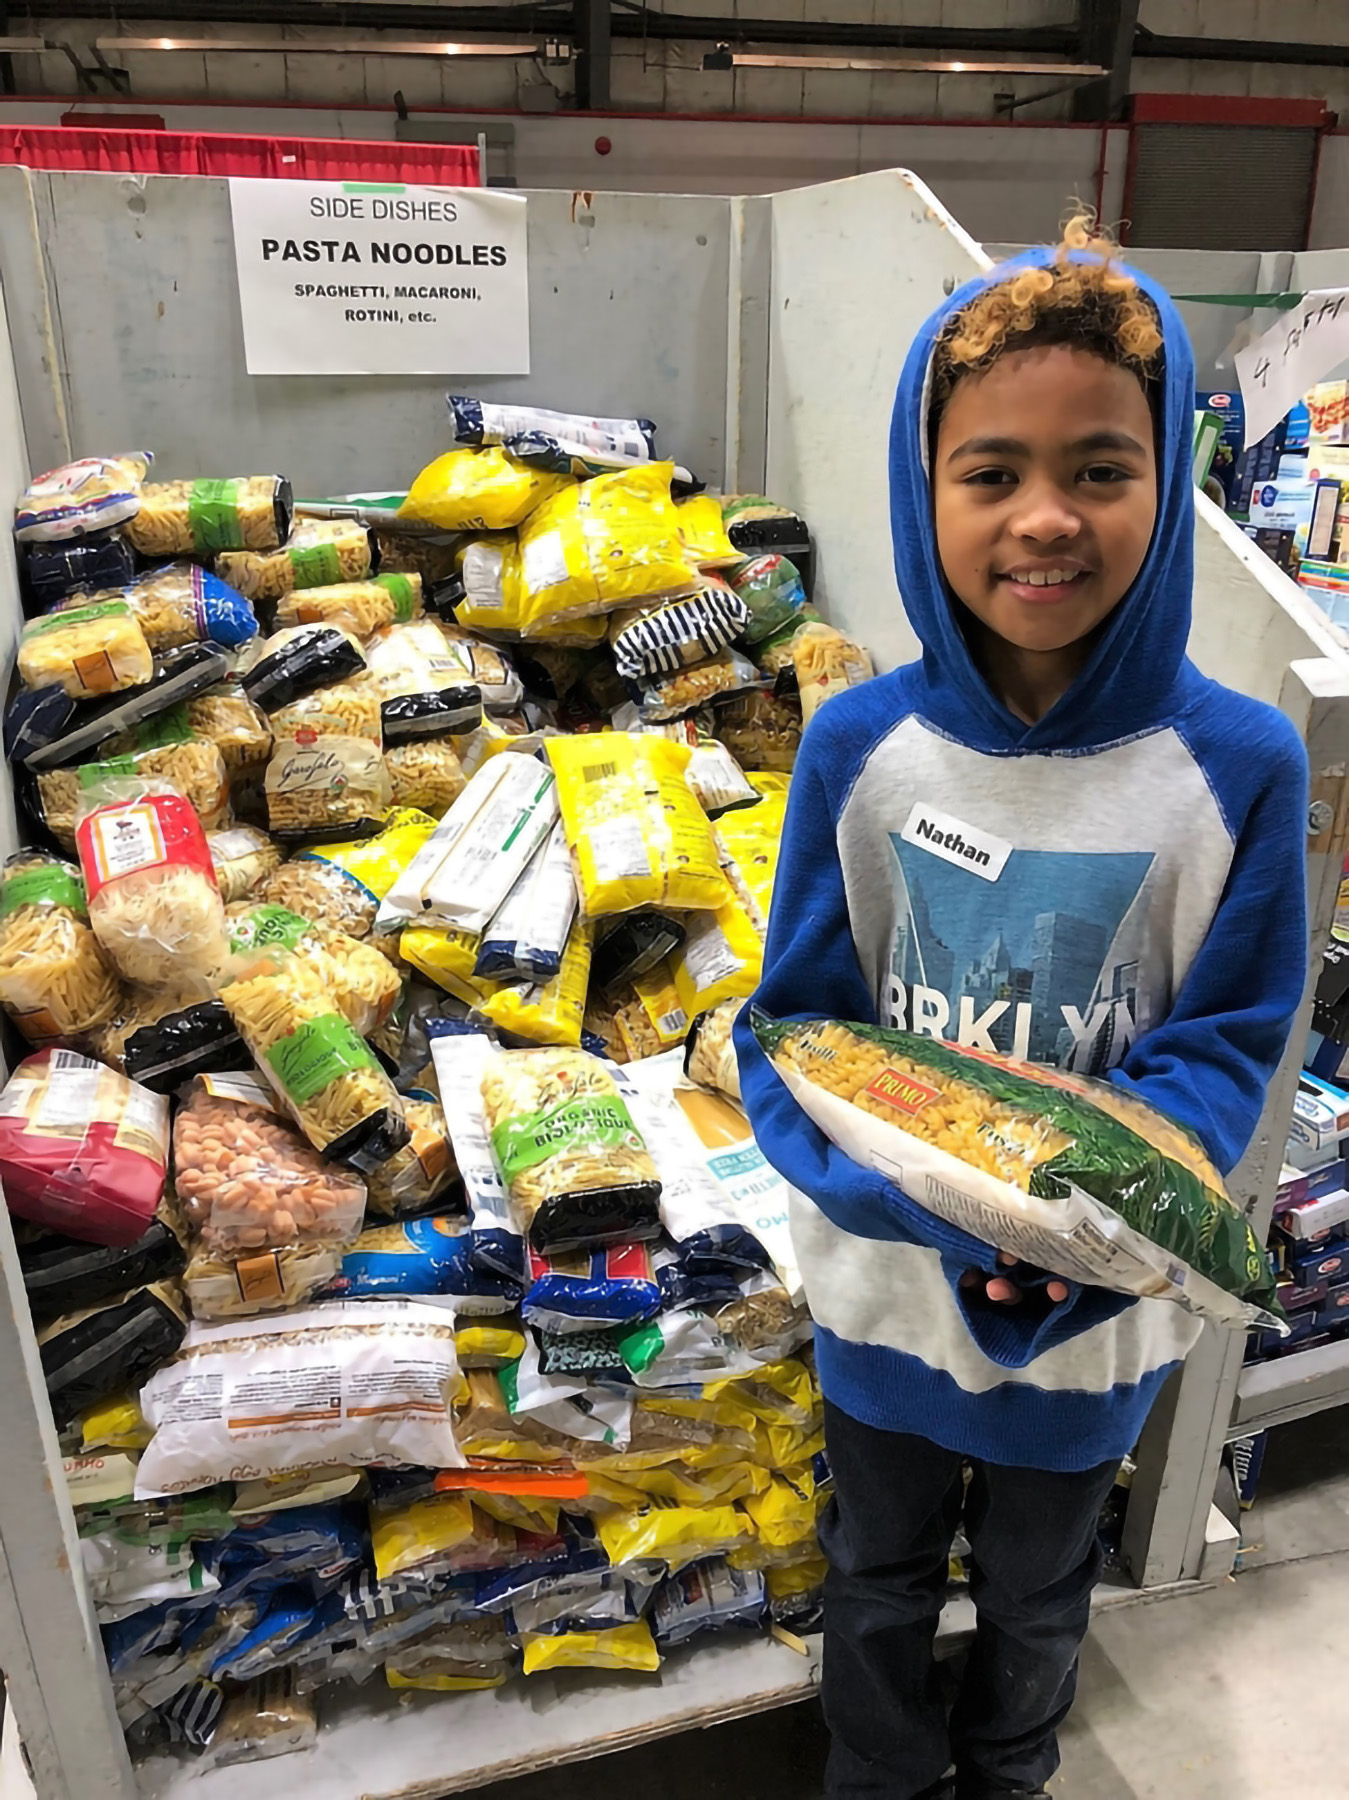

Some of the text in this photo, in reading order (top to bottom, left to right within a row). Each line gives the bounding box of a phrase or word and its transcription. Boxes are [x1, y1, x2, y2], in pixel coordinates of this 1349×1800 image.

[310, 196, 457, 222] SIDE DISHES
[261, 239, 507, 267] PASTA NOODLES
[294, 284, 481, 300] SPAGHETTI, MACARONI,
[344, 309, 437, 324] ROTINI, etc.
[916, 818, 991, 867] Nathan
[874, 1073, 928, 1106] PRIMO
[544, 1107, 617, 1130] ORGANIC
[534, 1117, 634, 1148] BIOLOIQUE
